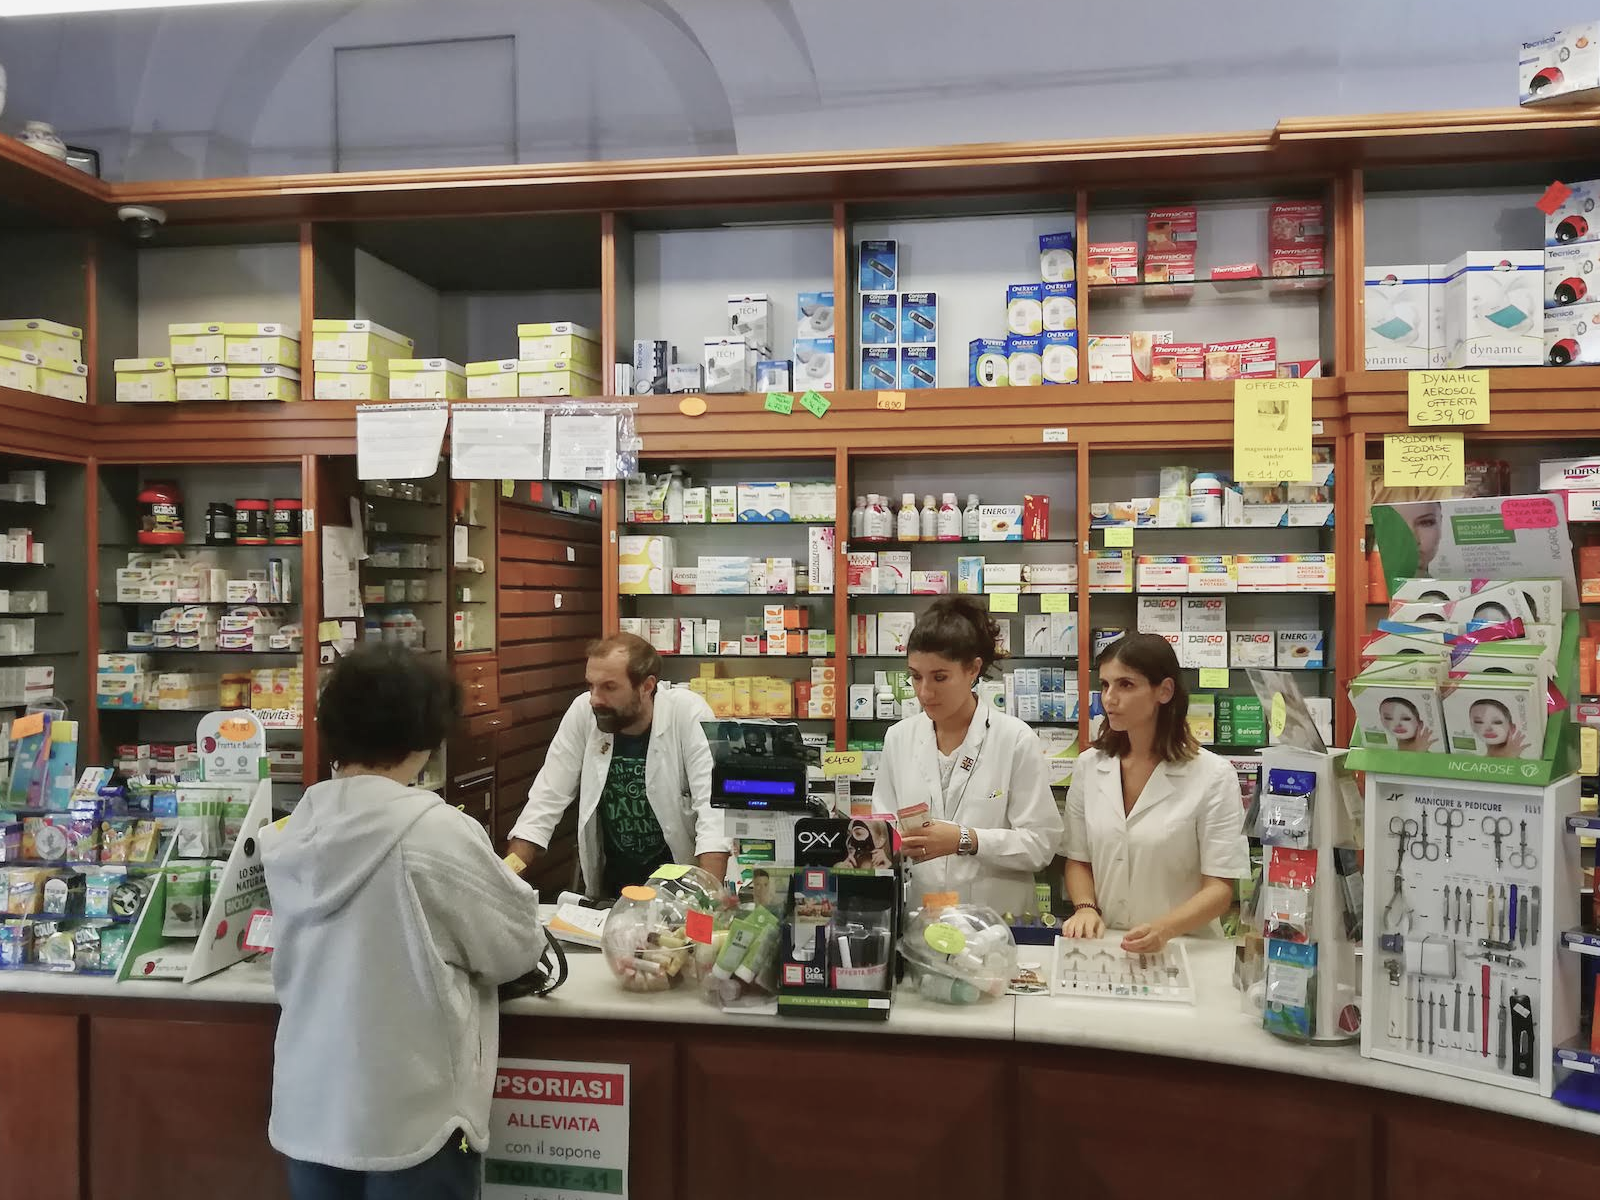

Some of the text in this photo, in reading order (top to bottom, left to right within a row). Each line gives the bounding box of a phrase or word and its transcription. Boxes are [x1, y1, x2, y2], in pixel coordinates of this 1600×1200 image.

[1522, 36, 1556, 50] Tecnico
[1275, 204, 1323, 213] ThermaCare
[1150, 210, 1195, 219] ThermaCare
[1089, 245, 1136, 255] ThermaCare
[1274, 248, 1322, 256] ThermaCare
[1548, 249, 1580, 258] Tecnico
[1146, 253, 1192, 261] ThermaCare
[1213, 265, 1253, 274] ThermaCare
[739, 307, 758, 315] TECH
[1154, 346, 1202, 355] ThermaCare
[1209, 340, 1271, 353] ThermaCare
[1470, 341, 1523, 359] dynamic
[716, 350, 735, 358] TECH
[1364, 354, 1409, 368] ynamic
[1421, 373, 1481, 386] DYNAMIC
[1245, 381, 1300, 391] OFFERTA
[1423, 387, 1476, 397] AEROSOL
[1427, 398, 1478, 408] OFFERTA
[1390, 434, 1443, 444] PRODOTTI
[1402, 444, 1452, 454] IODASE
[1400, 454, 1450, 464] SCONTATI
[1448, 761, 1515, 776] INCAROSE
[1414, 796, 1455, 808] MANICURE
[1464, 801, 1502, 812] PEDICURE
[798, 831, 841, 852] OXY
[496, 1075, 612, 1100] PSORIASI
[507, 1112, 600, 1132] ALLEVIATA
[505, 1140, 601, 1160] con il sapone
[494, 1162, 609, 1190] TOLOF-41
